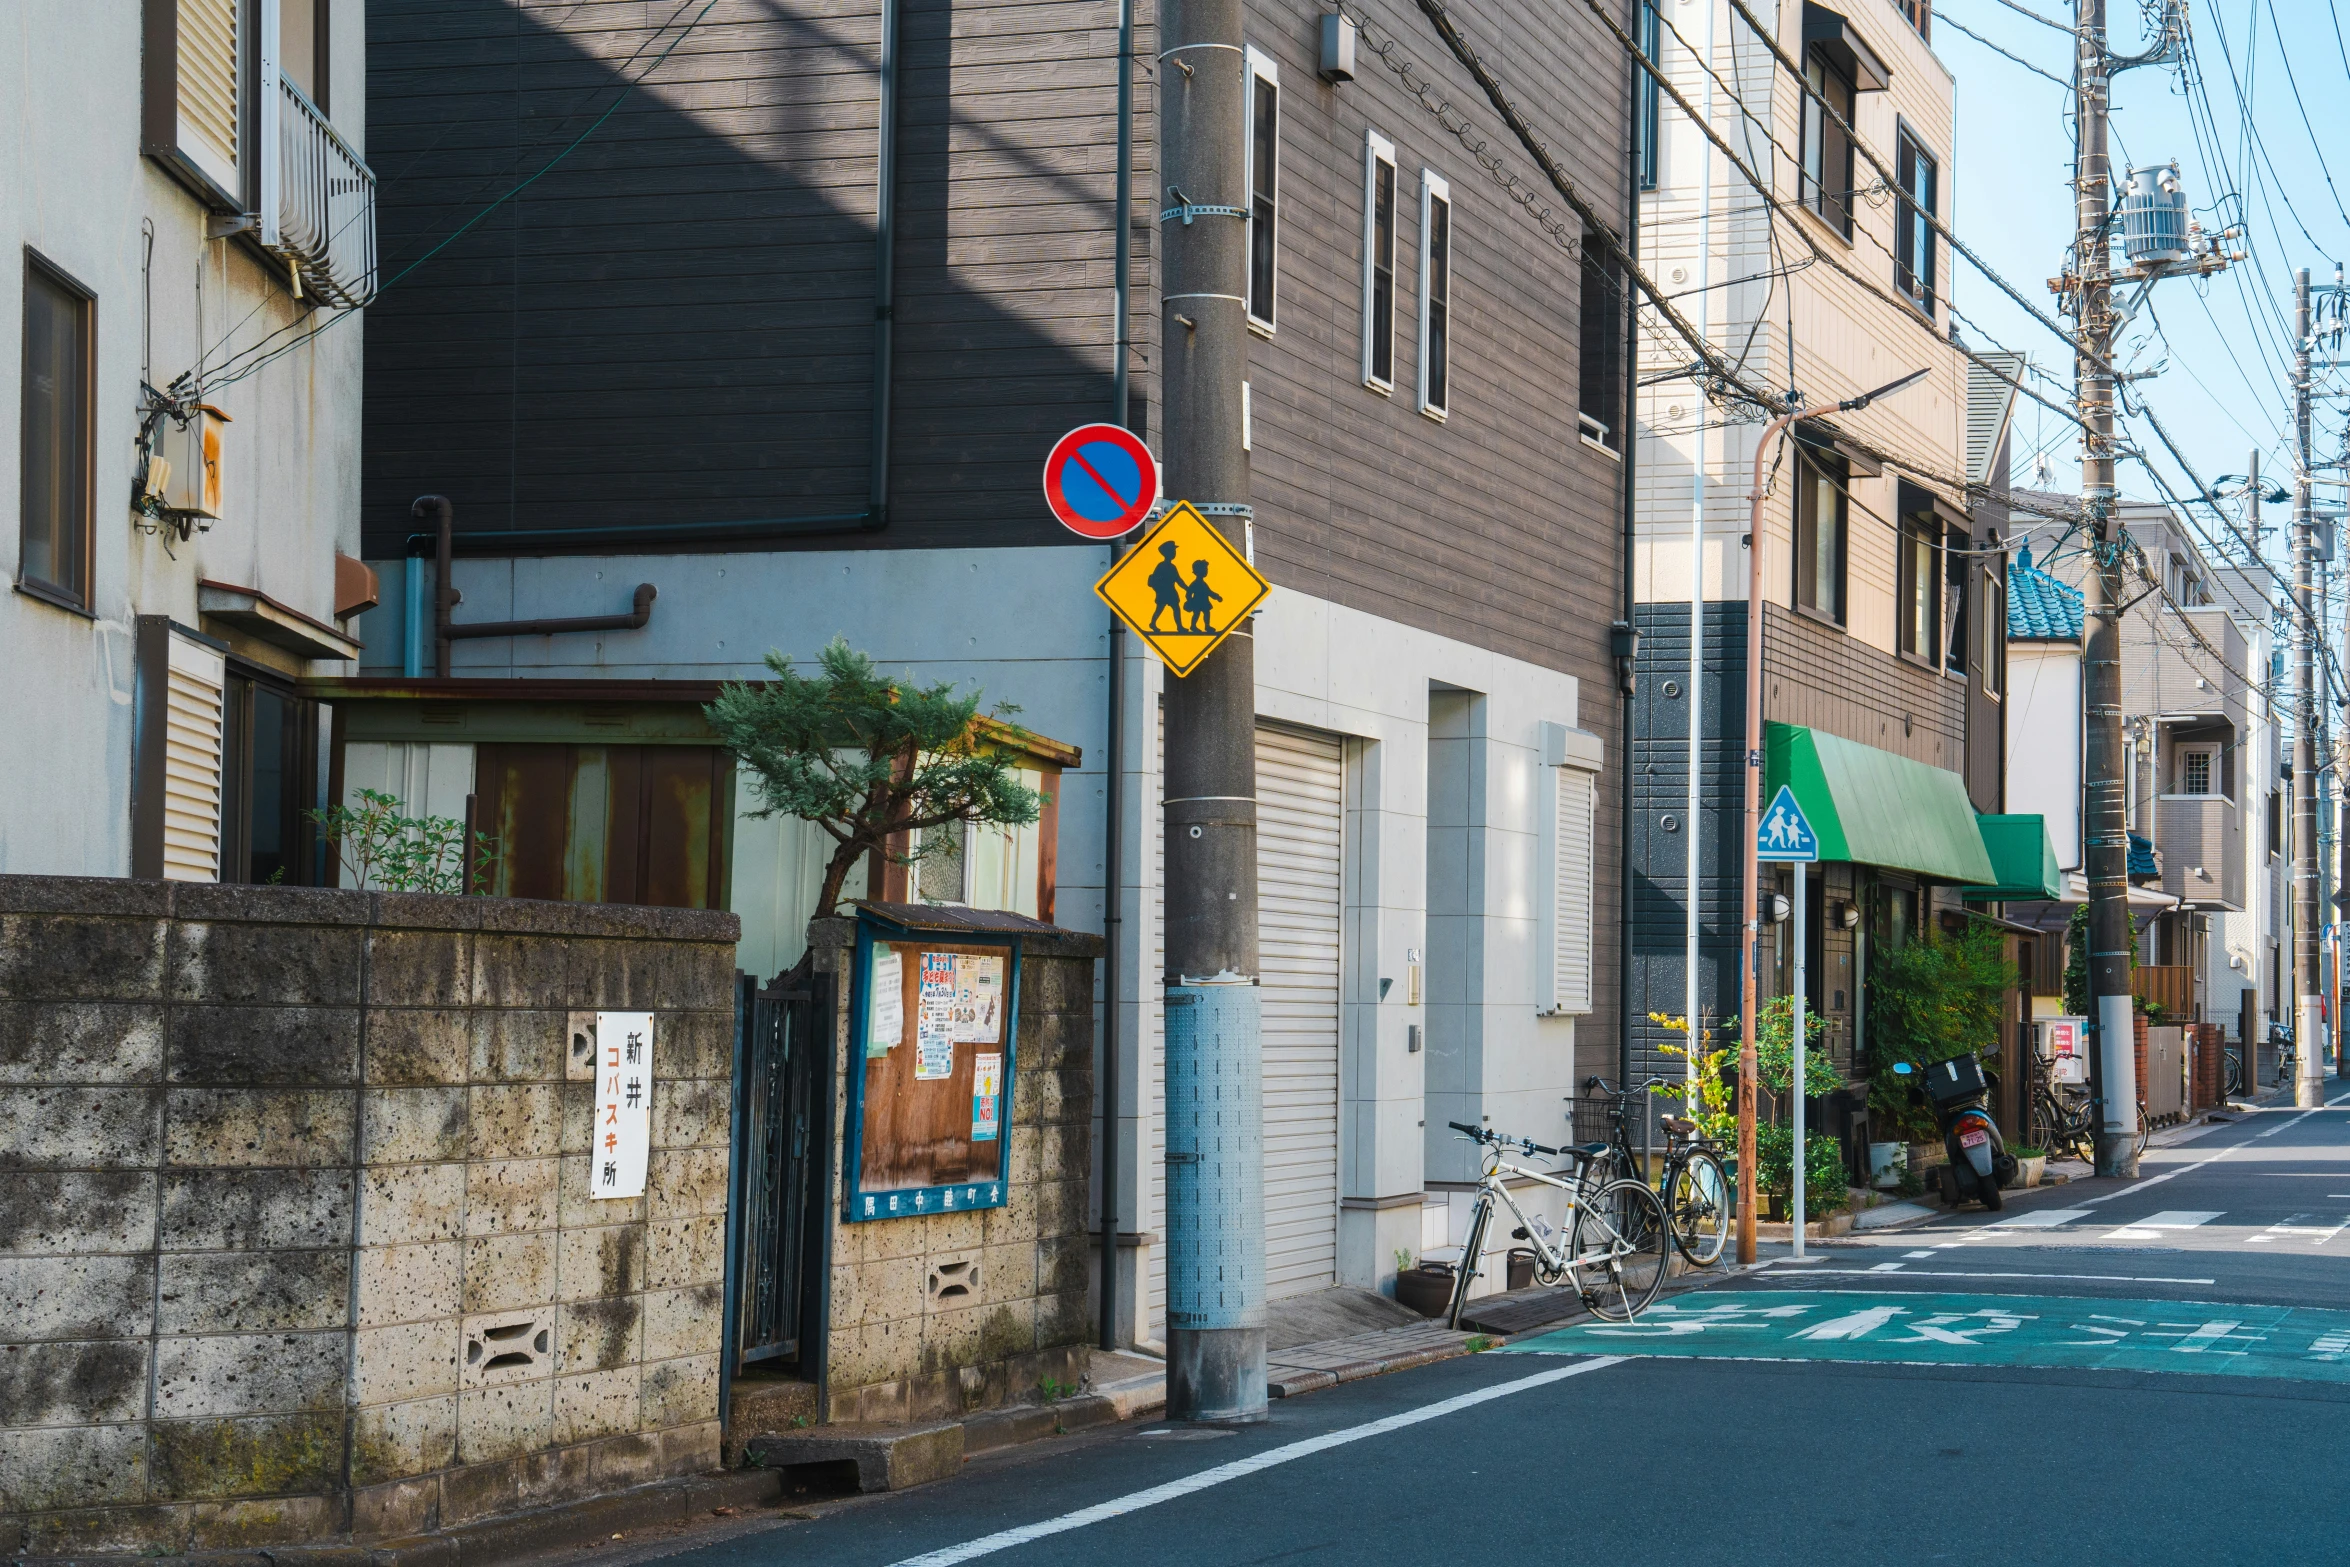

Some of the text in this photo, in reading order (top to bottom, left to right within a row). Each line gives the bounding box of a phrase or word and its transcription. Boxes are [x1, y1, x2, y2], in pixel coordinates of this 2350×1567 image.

[626, 1032, 643, 1109] 新井
[603, 1047, 620, 1187] コバスキ所
[980, 1108, 994, 1121] NO!
